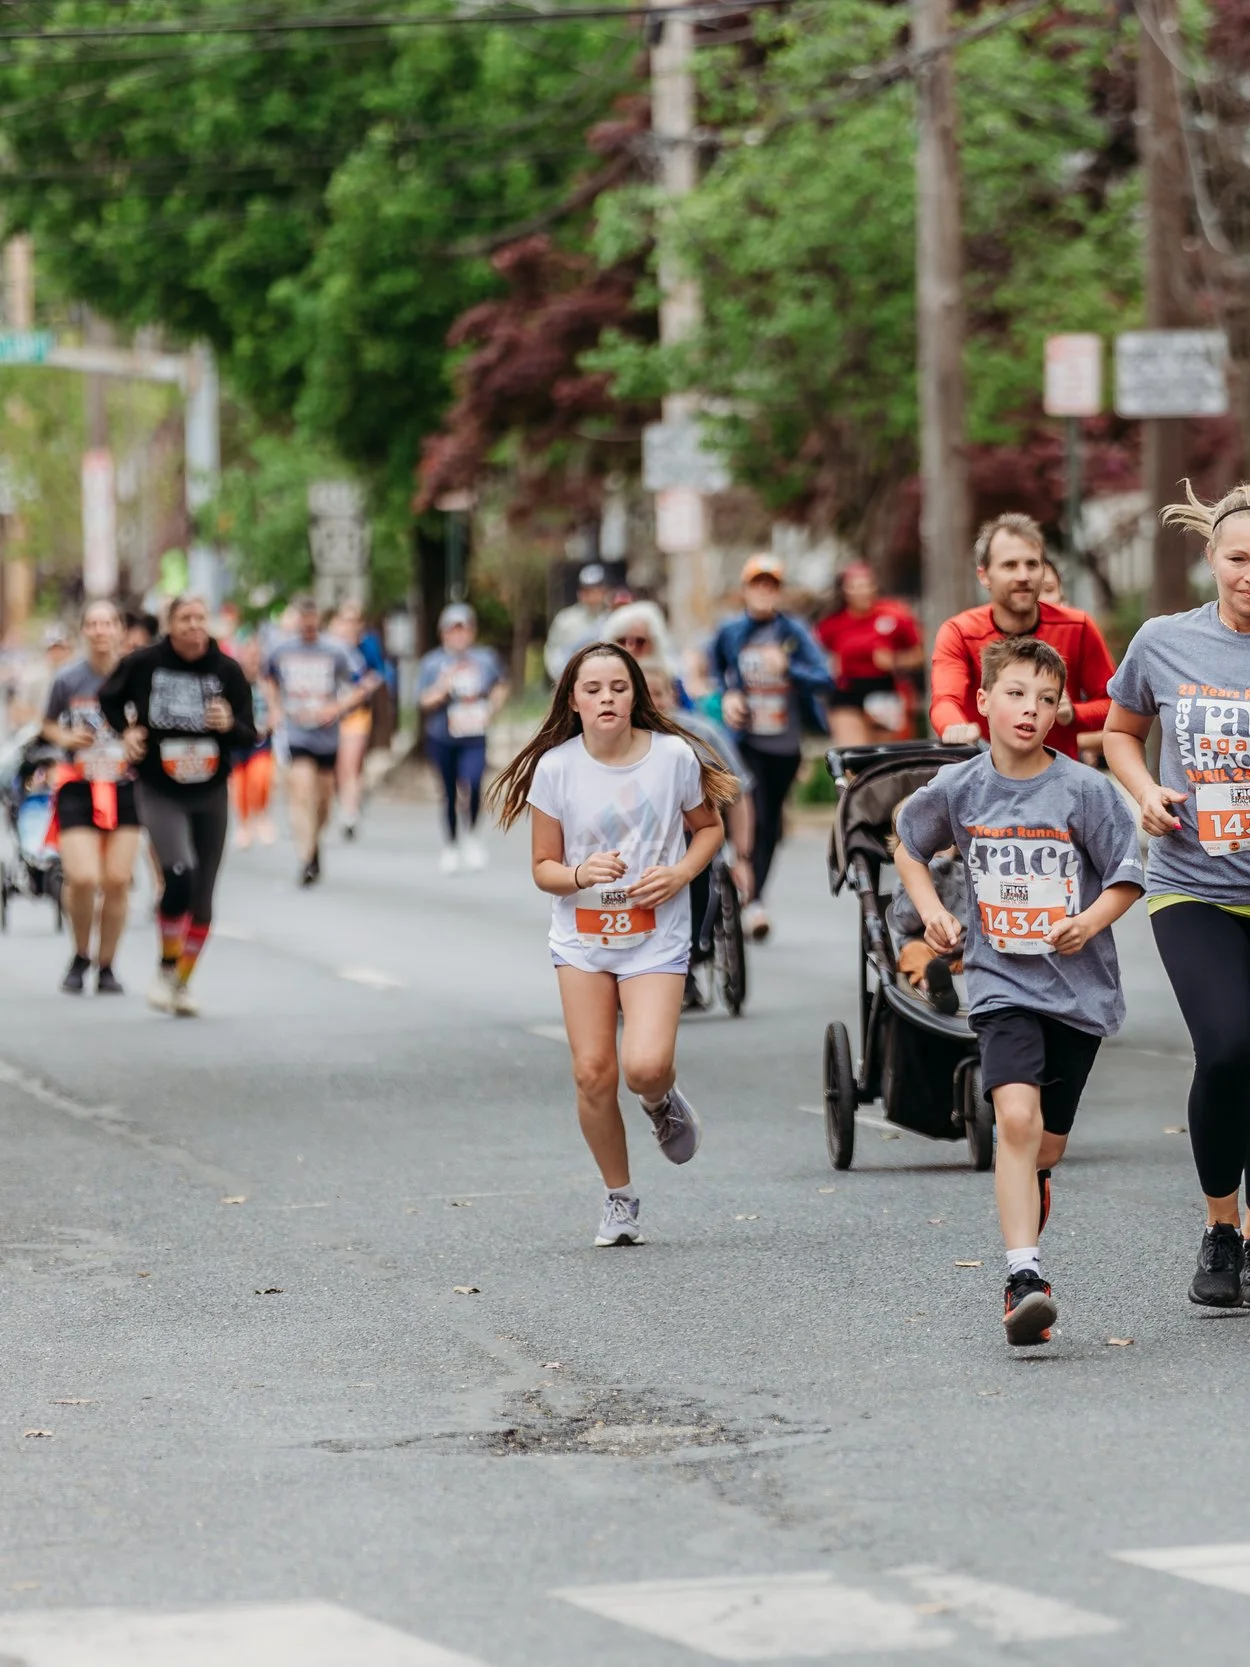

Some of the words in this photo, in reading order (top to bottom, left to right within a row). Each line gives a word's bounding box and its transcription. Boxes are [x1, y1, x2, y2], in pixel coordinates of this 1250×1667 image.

[1178, 683, 1196, 696] 28
[1200, 684, 1240, 699] Years
[976, 825, 1014, 837] Years
[1017, 826, 1072, 843] Runnin
[976, 844, 1080, 877] race
[599, 912, 632, 934] 28
[985, 907, 1052, 936] 1434
